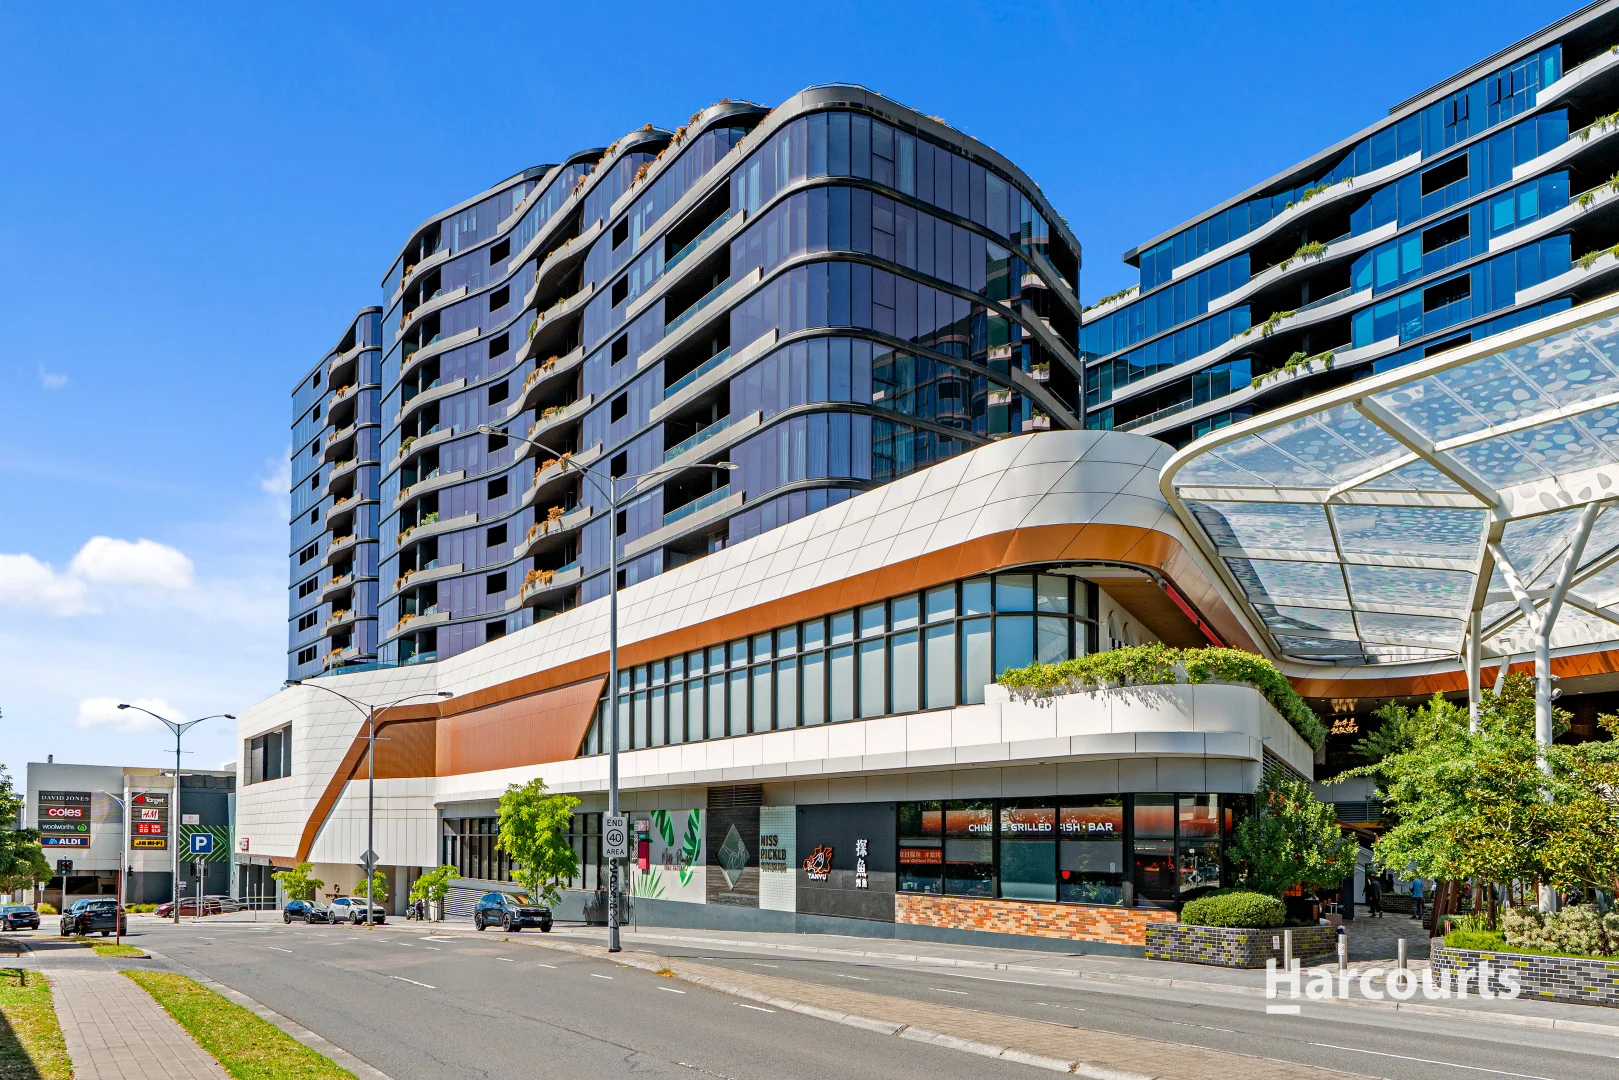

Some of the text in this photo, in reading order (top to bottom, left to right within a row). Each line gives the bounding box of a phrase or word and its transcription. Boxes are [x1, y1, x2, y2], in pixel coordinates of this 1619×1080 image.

[145, 796, 164, 804] Target
[48, 808, 82, 817] coles
[606, 819, 623, 827] END
[968, 823, 1009, 832] CHINEE
[1011, 823, 1052, 832] GRILLED
[1088, 822, 1114, 832] BAR
[608, 833, 622, 842] 40
[195, 836, 208, 851] P
